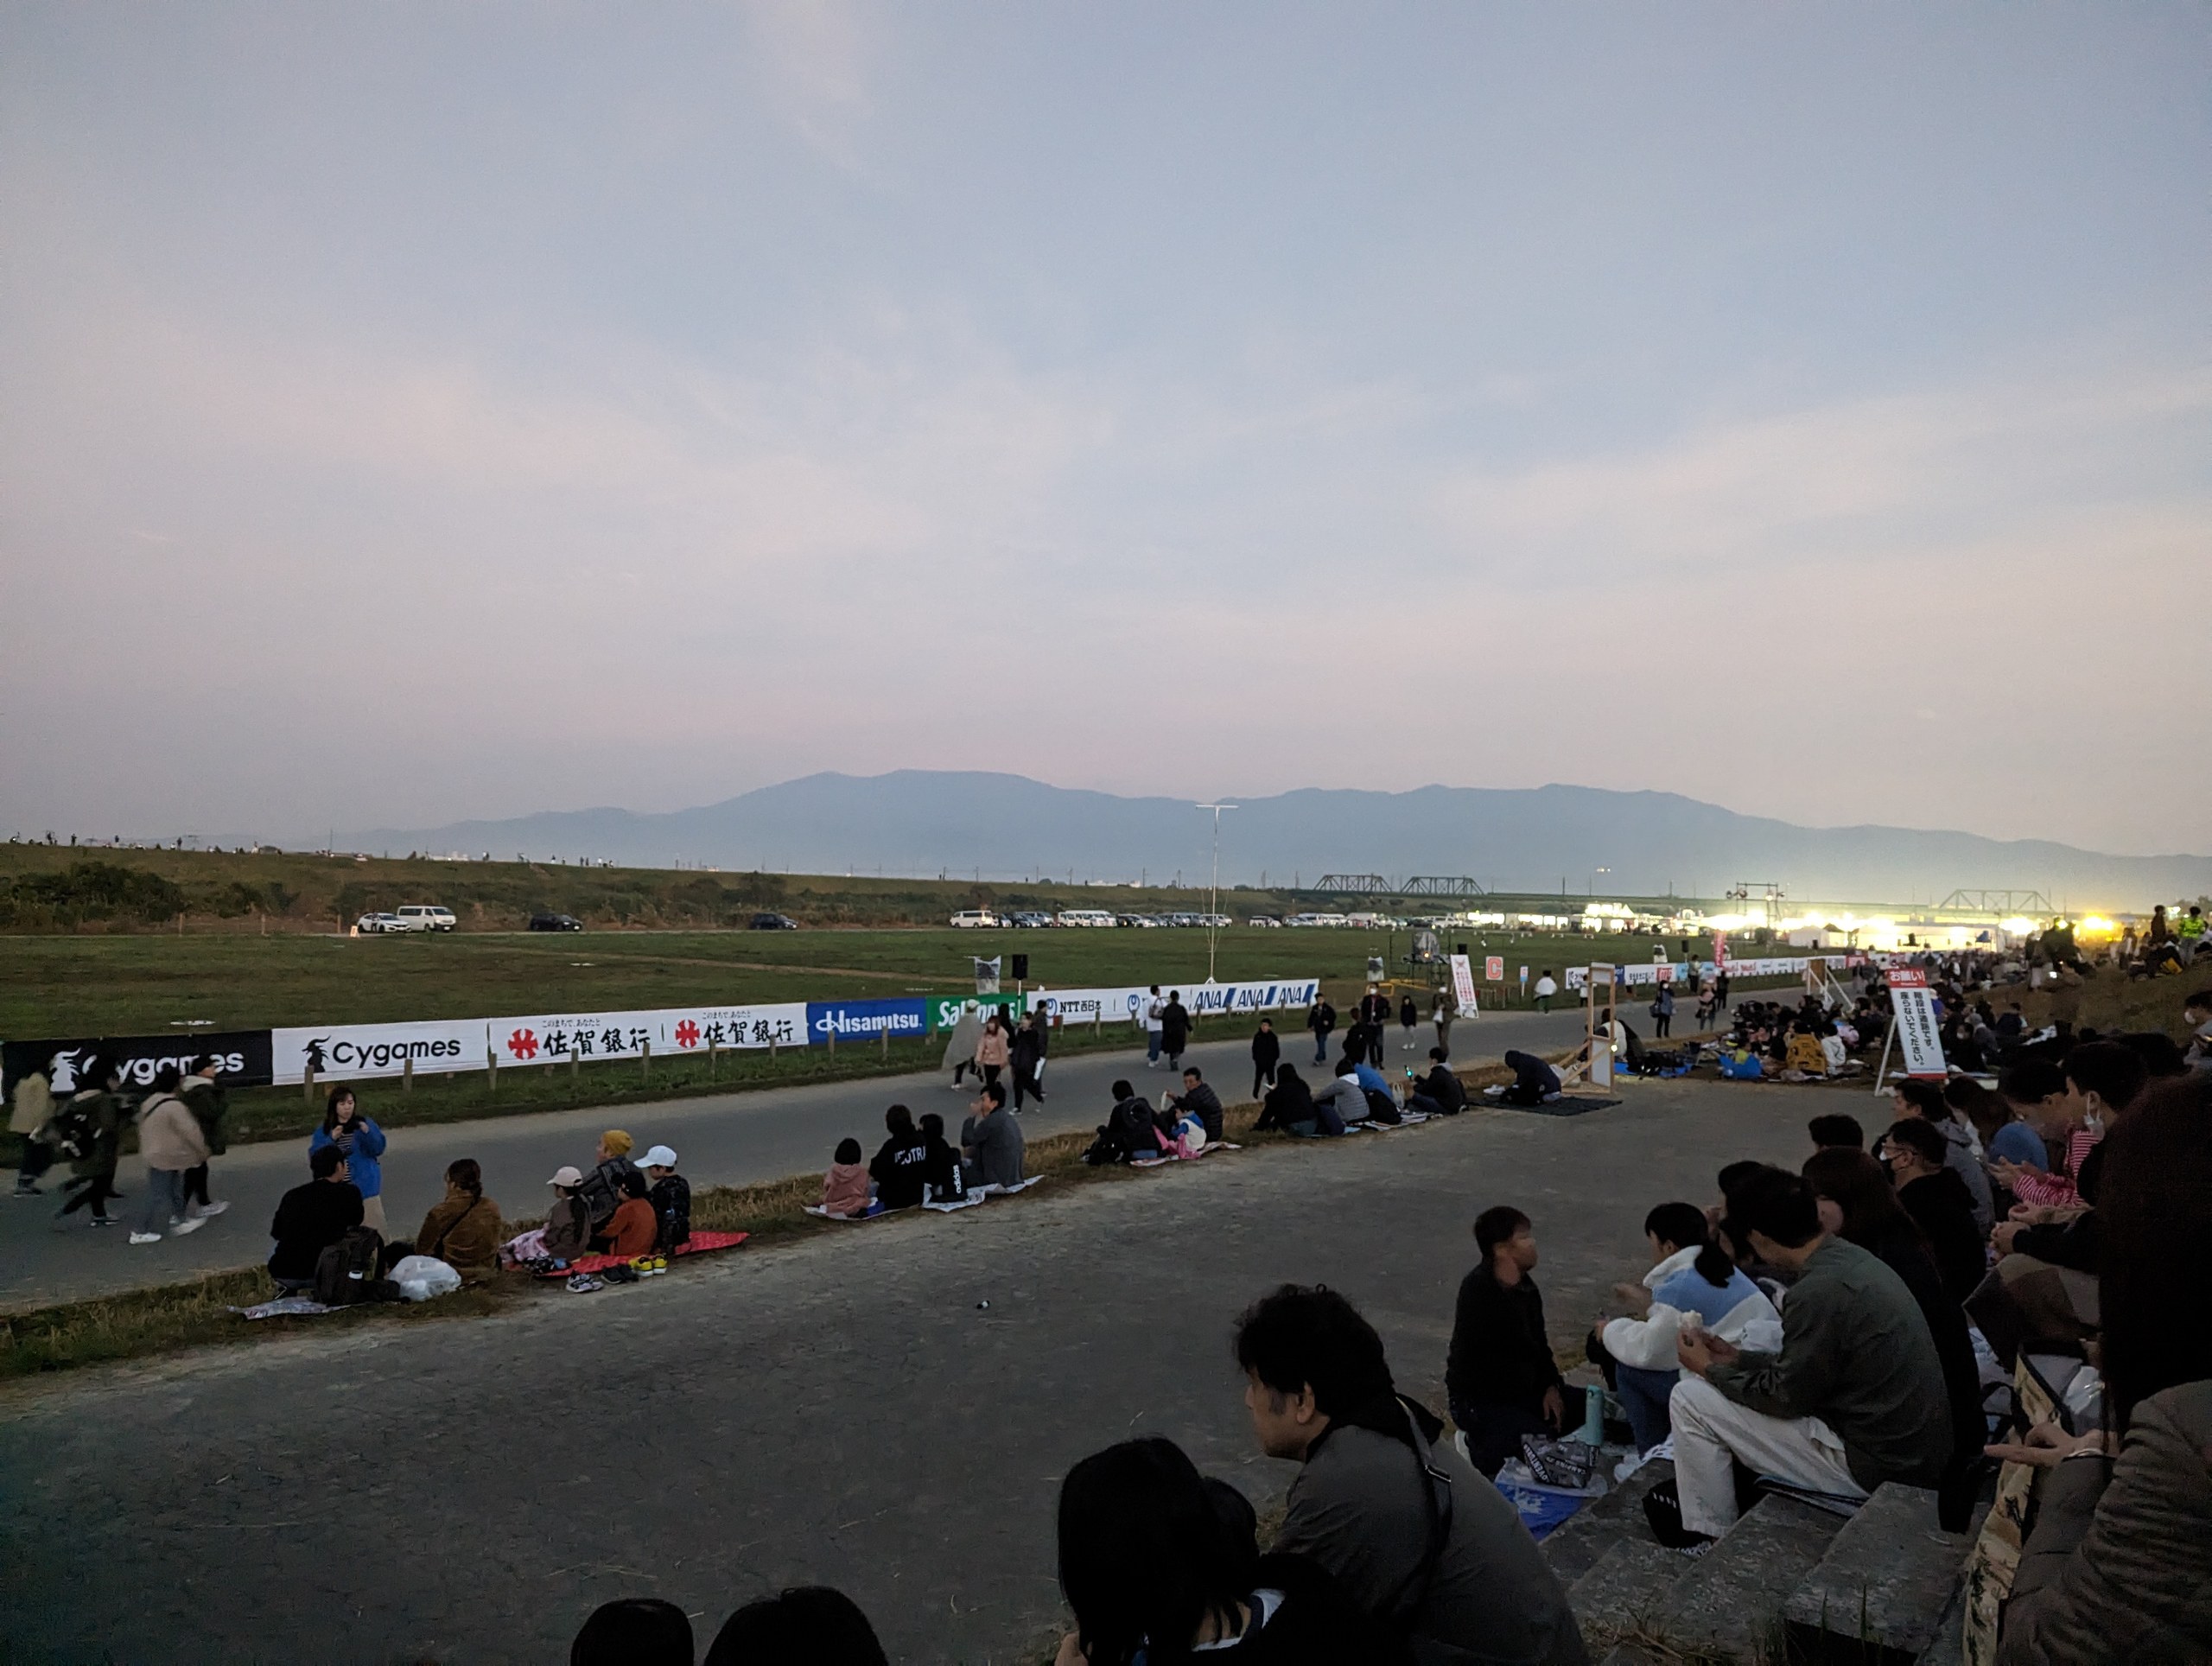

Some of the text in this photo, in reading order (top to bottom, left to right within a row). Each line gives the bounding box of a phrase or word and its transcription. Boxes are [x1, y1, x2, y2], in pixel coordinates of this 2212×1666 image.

[1487, 957, 1503, 979] C
[1193, 987, 1301, 1009] ANA ANA ANA
[938, 1000, 1015, 1027] Salnps
[543, 1027, 651, 1057] 佐賀銀行
[703, 1019, 793, 1044] 佐賀銀行
[333, 1040, 461, 1068] Cygames
[953, 1164, 962, 1193] adidas
